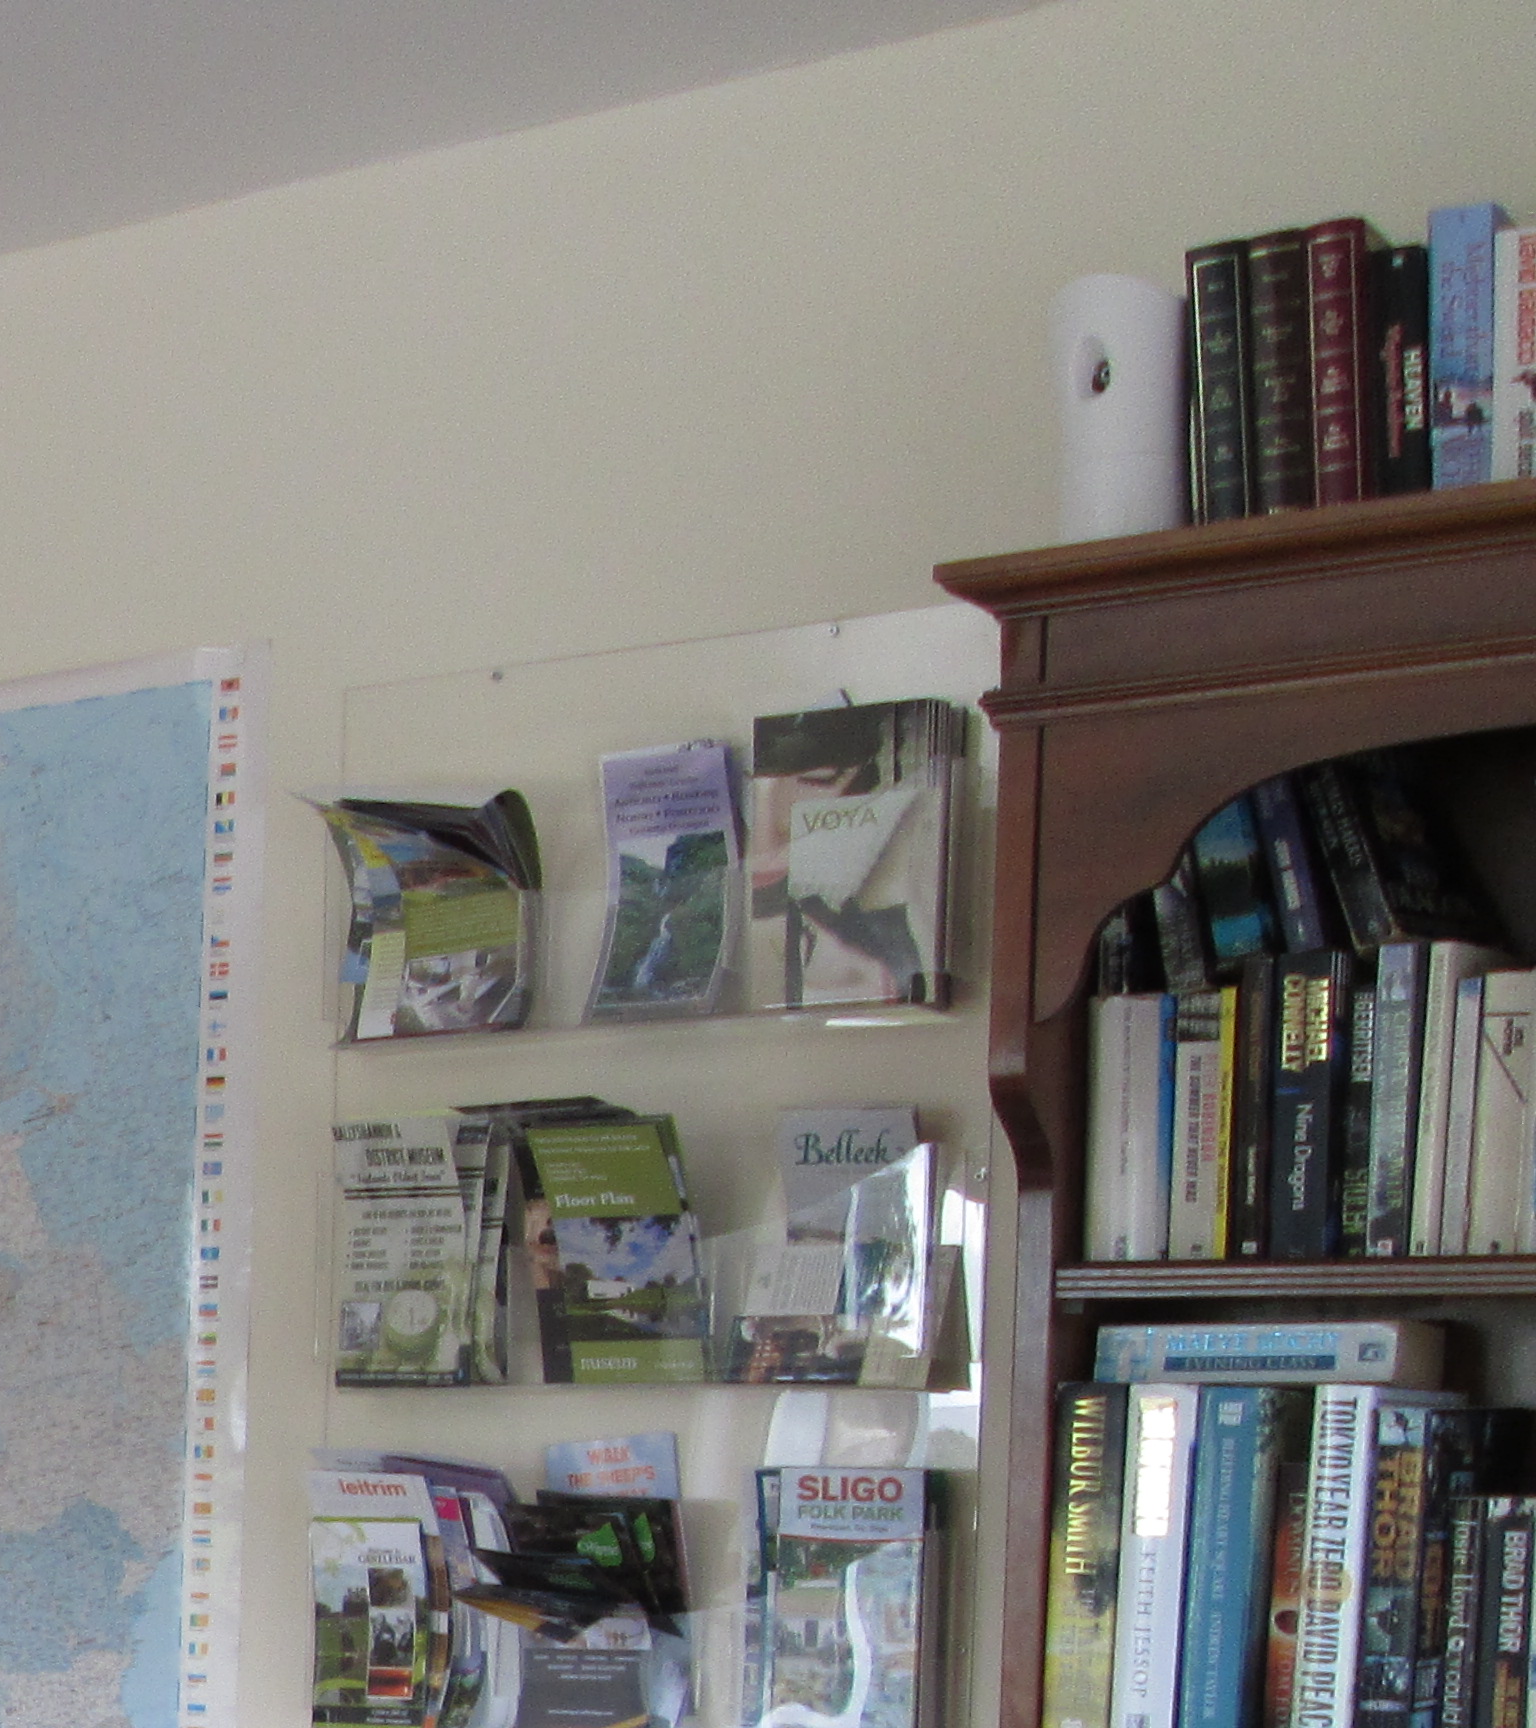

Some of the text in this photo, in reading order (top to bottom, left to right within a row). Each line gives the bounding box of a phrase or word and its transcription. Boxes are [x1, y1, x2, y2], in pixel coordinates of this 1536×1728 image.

[803, 806, 878, 834] VOYA
[1305, 978, 1330, 1064] MICHAEL
[794, 1129, 893, 1166] Belleek
[1287, 1103, 1315, 1211] Nine Dragons
[555, 1190, 635, 1208] Floor Plan
[1068, 1396, 1107, 1496] WILBUR
[1320, 1397, 1357, 1469] TOKYO
[338, 1478, 408, 1497] leitrim
[796, 1473, 904, 1503] SLIGO
[798, 1504, 904, 1521] FOLK PARK
[1313, 1474, 1352, 1531] YEAR
[1371, 1456, 1399, 1579] THOR
[1394, 1449, 1423, 1582] BRAD
[1064, 1501, 1097, 1576] SMITH
[1309, 1536, 1347, 1591] ZERO
[1502, 1530, 1527, 1590] BRAD
[1130, 1551, 1157, 1699] KEITH JESSOP
[1444, 1573, 1474, 1629] Lloyd
[1498, 1593, 1525, 1654] THOR
[1303, 1598, 1342, 1665] DAVID
